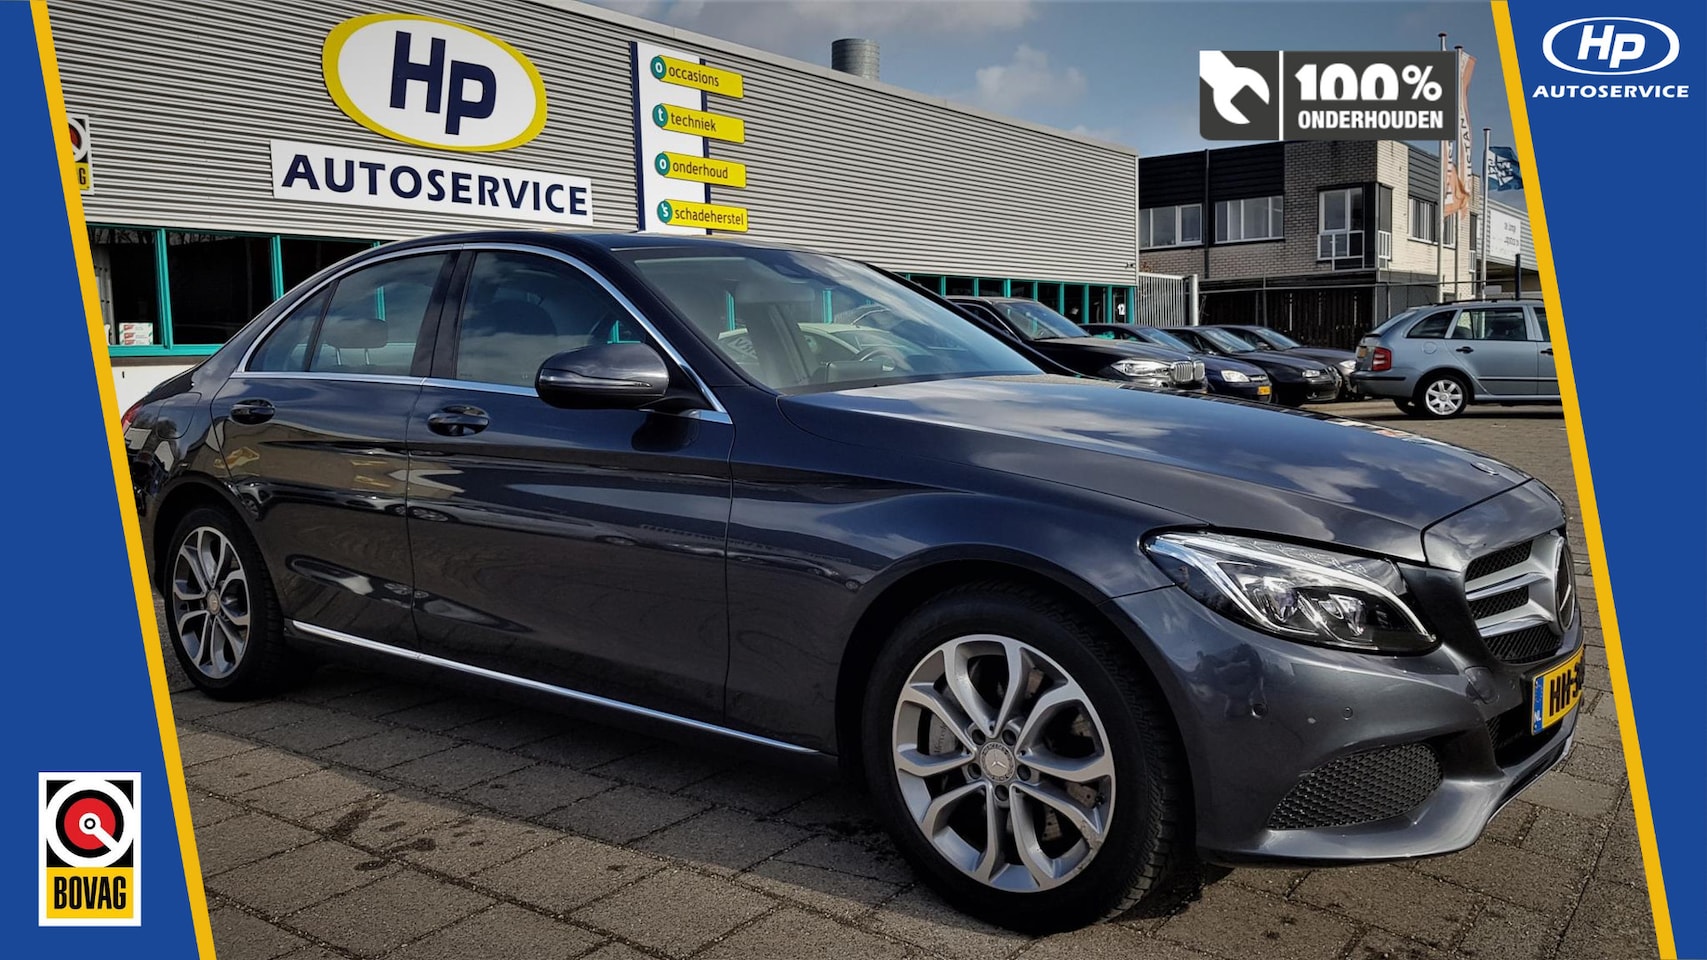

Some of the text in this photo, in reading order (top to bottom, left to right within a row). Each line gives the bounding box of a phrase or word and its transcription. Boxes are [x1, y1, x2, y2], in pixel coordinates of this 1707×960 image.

[668, 66, 720, 87] occasions
[671, 112, 717, 132] techniek
[672, 161, 729, 179] onderhoud
[281, 154, 588, 216] AUTOSERVICE
[675, 207, 744, 226] schadeherstel
[1117, 303, 1126, 316] 12
